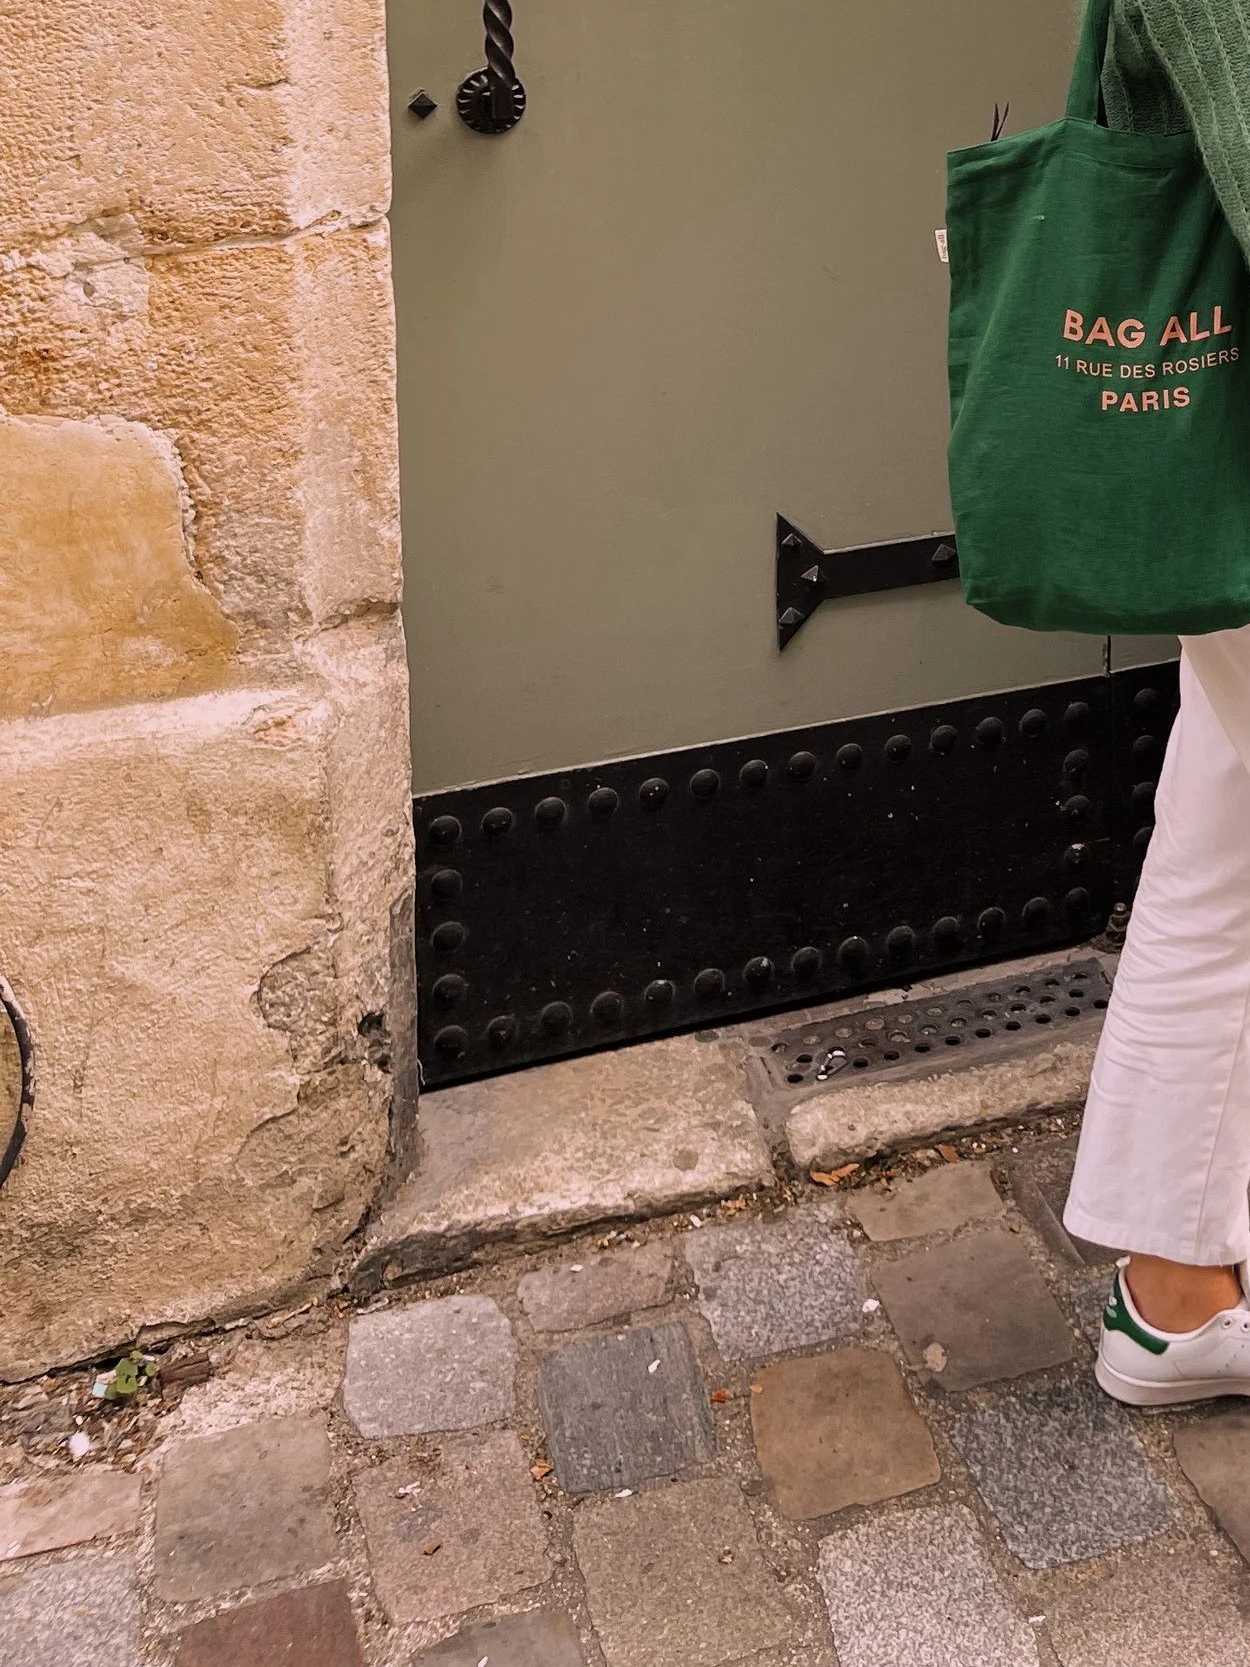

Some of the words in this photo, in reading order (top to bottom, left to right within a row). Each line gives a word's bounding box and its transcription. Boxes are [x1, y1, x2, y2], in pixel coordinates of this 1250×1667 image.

[1063, 309, 1146, 349] BAG
[1159, 305, 1233, 347] ALL
[1055, 354, 1070, 370] 11
[1076, 359, 1113, 377] RUE
[1119, 364, 1156, 379] DES
[1162, 347, 1240, 375] ROSIERS
[1101, 386, 1191, 413] PARIS
